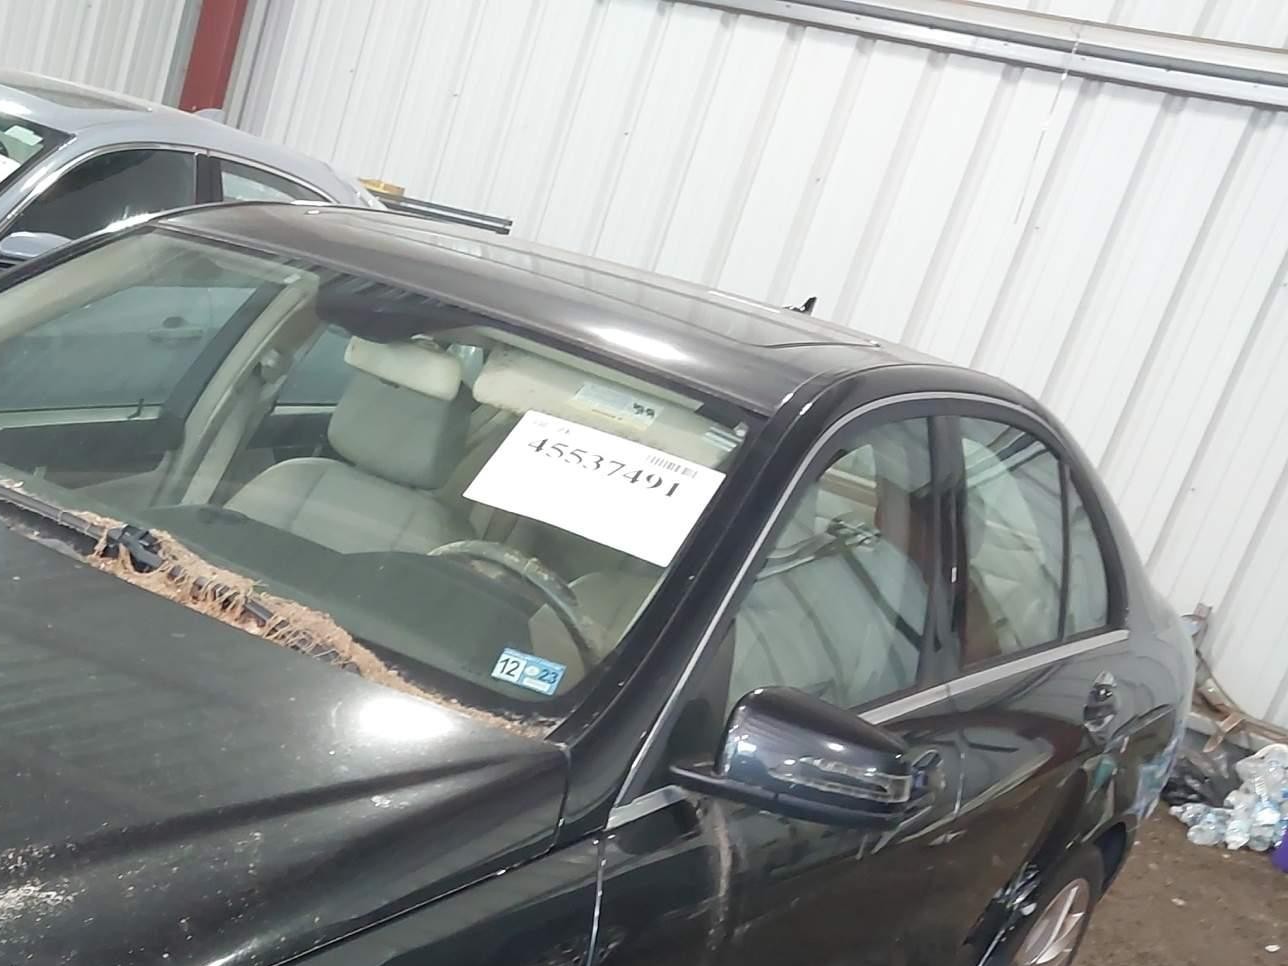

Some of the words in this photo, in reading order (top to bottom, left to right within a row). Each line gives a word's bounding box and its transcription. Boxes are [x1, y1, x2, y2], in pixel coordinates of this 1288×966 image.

[528, 437, 680, 497] 45537491
[500, 658, 520, 677] 12
[538, 668, 558, 684] 23
